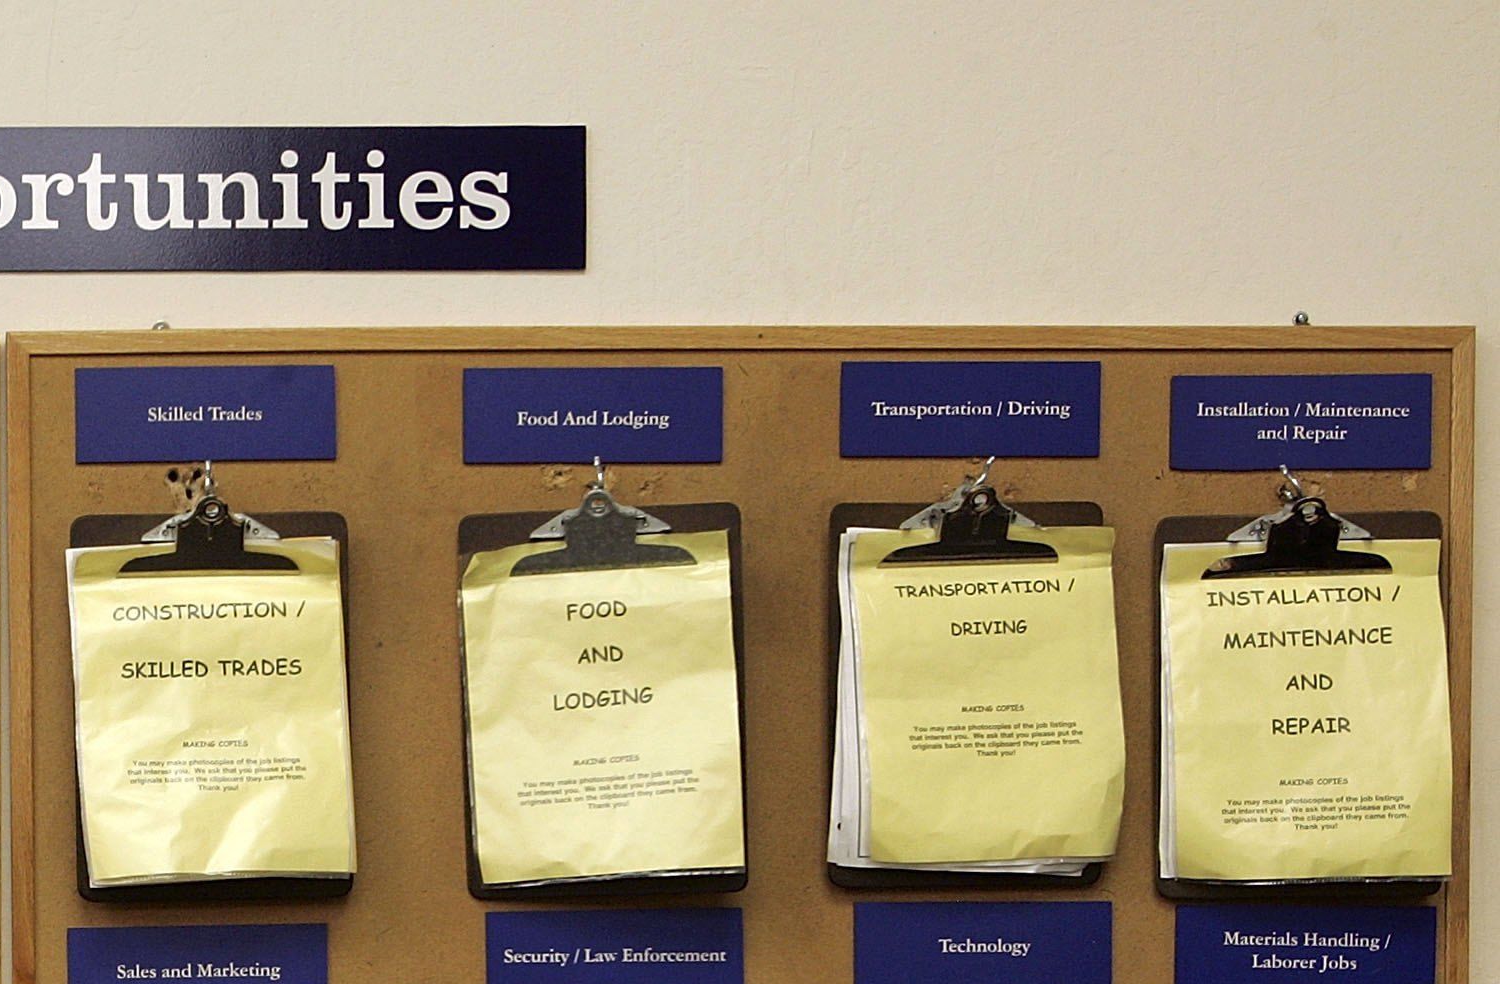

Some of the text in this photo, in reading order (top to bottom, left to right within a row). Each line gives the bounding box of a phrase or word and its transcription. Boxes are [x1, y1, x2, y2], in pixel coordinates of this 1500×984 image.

[147, 405, 262, 422] Skilled Trades
[871, 401, 991, 419] Transportation
[1007, 400, 1070, 419] Driving
[1196, 401, 1289, 416] Installation
[1305, 402, 1409, 417] Maintenance
[517, 410, 669, 429] Food And Lodging
[1257, 424, 1347, 443] and Repair
[894, 579, 1060, 597] TRANSPORTATION
[1206, 586, 1381, 607] INSTALLATION
[112, 601, 286, 621] CONSTRUCTION
[566, 600, 627, 621] FOOD
[951, 619, 1027, 636] DRIVING
[1223, 626, 1392, 649] MAINTENANCE
[577, 645, 623, 664] AND
[121, 657, 301, 678] SKILLED TRADES
[1285, 673, 1333, 691] AND
[553, 686, 653, 711] LODGING
[1272, 717, 1350, 735] REPAIR
[182, 740, 215, 748] MAKING
[1278, 777, 1348, 786] MAKING COPIES
[938, 938, 1030, 956] Technology
[1223, 931, 1298, 946] Materials
[1303, 932, 1380, 951] Handling
[503, 948, 570, 966] Security
[584, 948, 617, 962] Law
[621, 947, 726, 962] Enforcement
[1252, 953, 1356, 973] Laborer Jobs
[116, 962, 280, 980] Sales and Marketing
